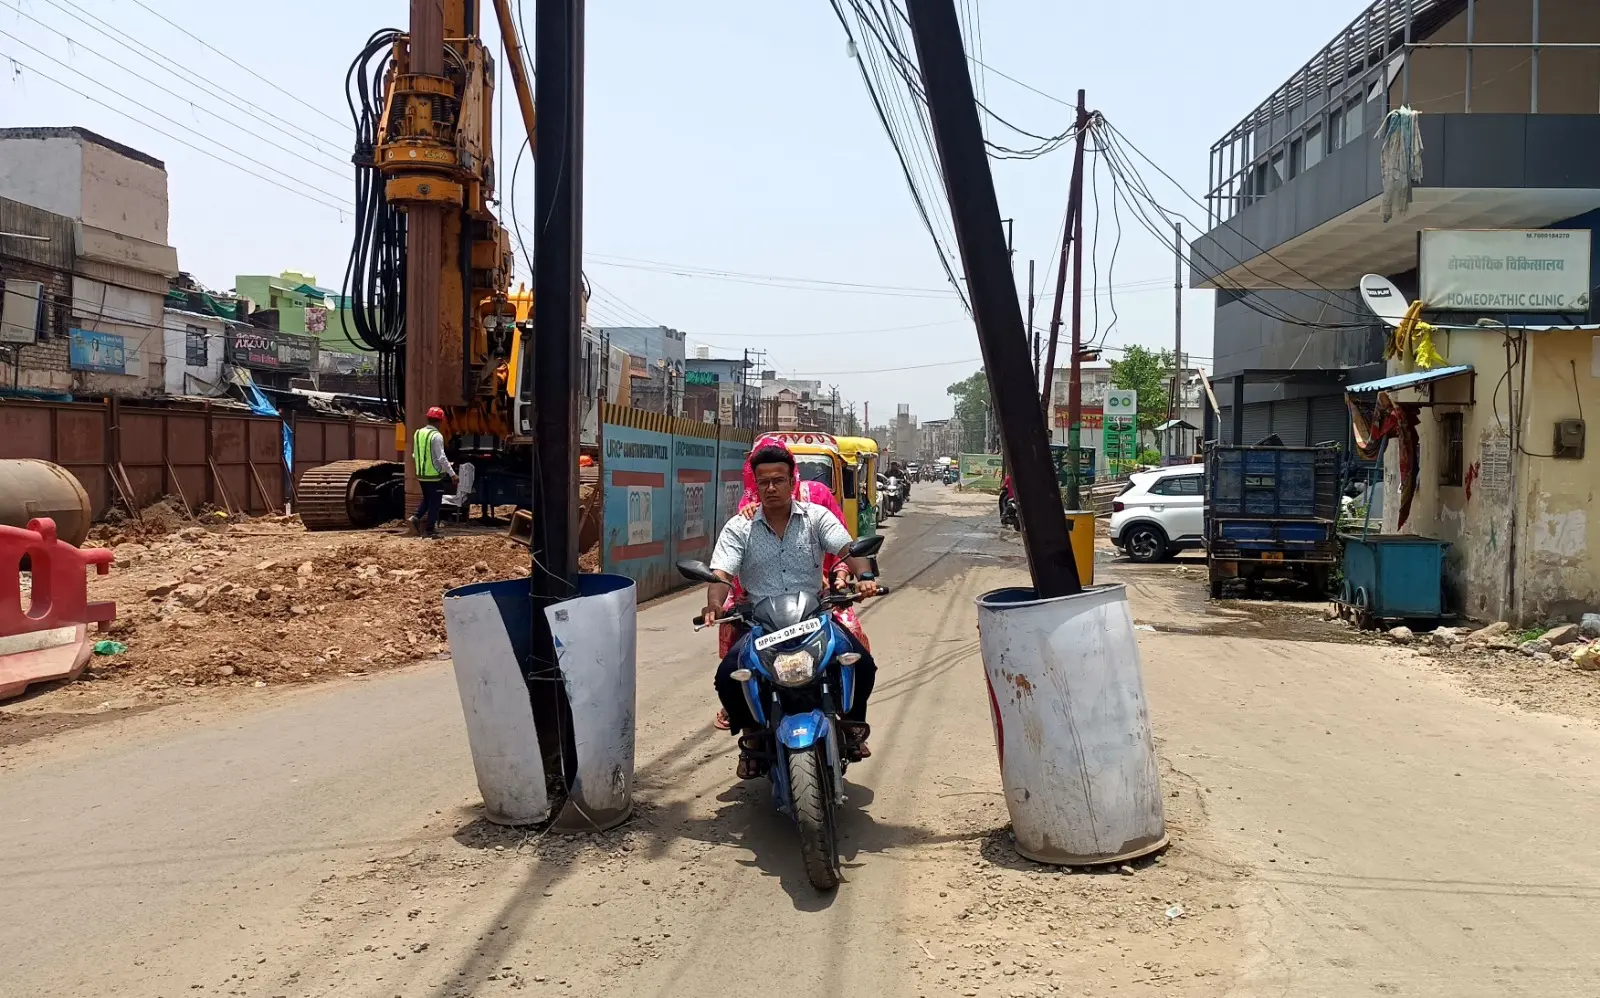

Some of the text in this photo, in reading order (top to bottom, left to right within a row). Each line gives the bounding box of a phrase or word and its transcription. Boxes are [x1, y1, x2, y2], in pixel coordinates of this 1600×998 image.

[1506, 255, 1564, 271] चिकित्सालय
[1447, 293, 1564, 306] HOMEOPATHIC CLINIC
